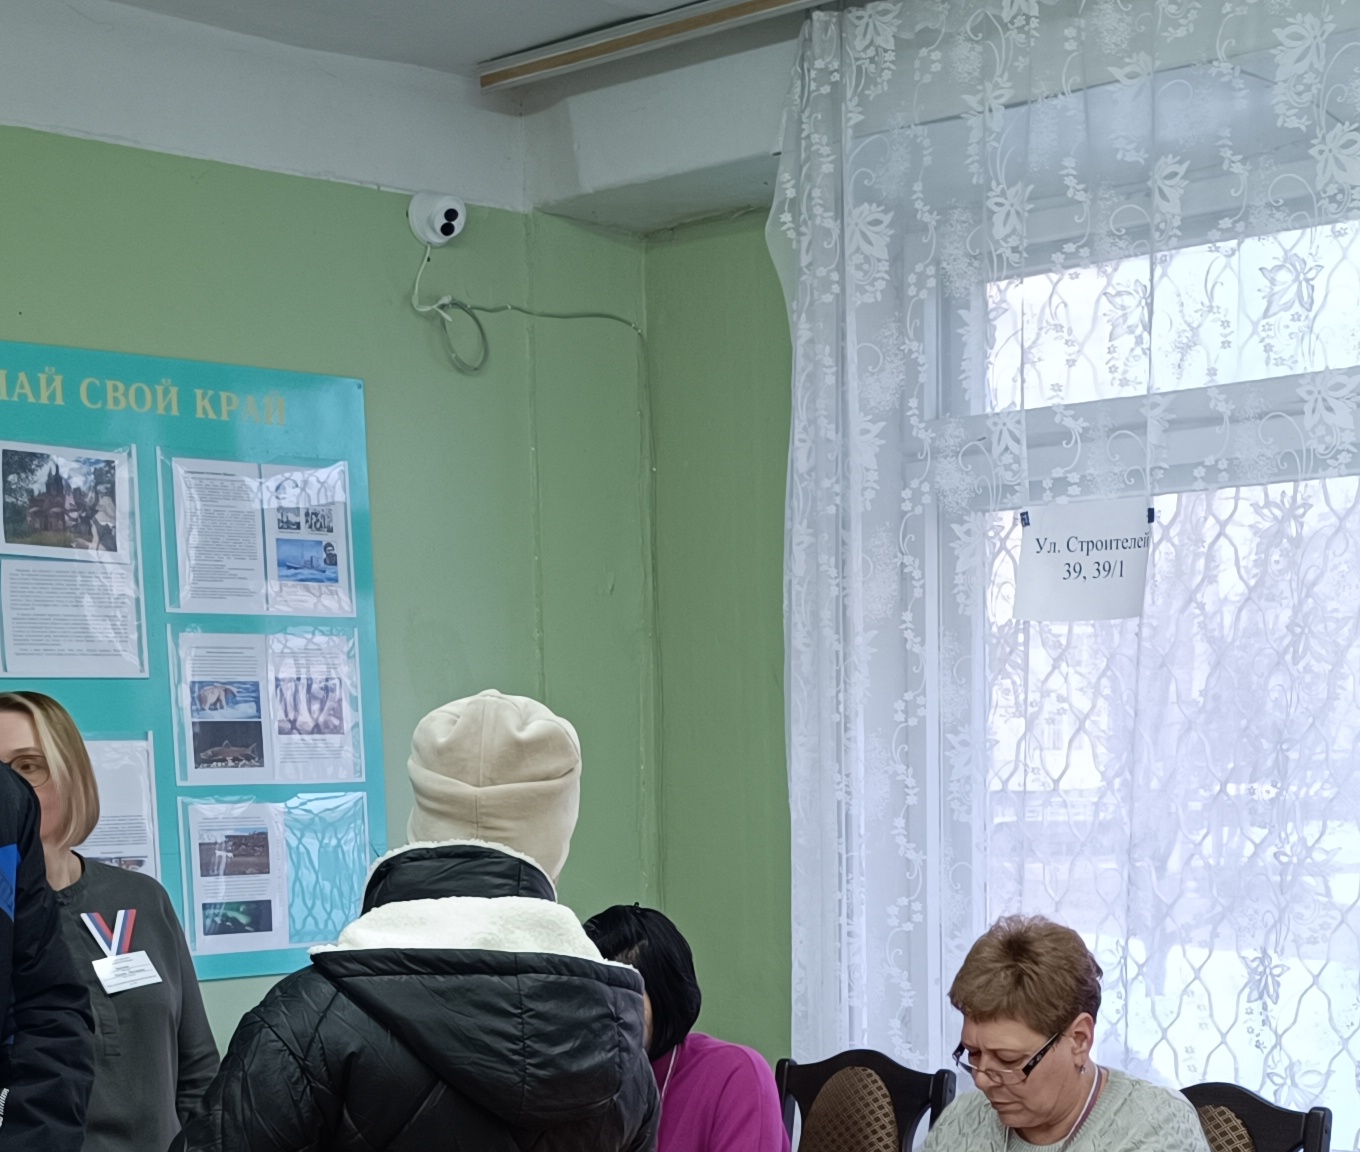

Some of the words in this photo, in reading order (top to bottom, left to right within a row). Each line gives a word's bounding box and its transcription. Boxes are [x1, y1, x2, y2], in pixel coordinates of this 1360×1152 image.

[79, 377, 180, 416] СВОЙ
[194, 388, 286, 426] КРАЙ
[1035, 537, 1061, 554] Ул.
[1066, 531, 1151, 557] Строителей
[1062, 561, 1087, 583] 39,
[1092, 559, 1124, 579] 39/1
